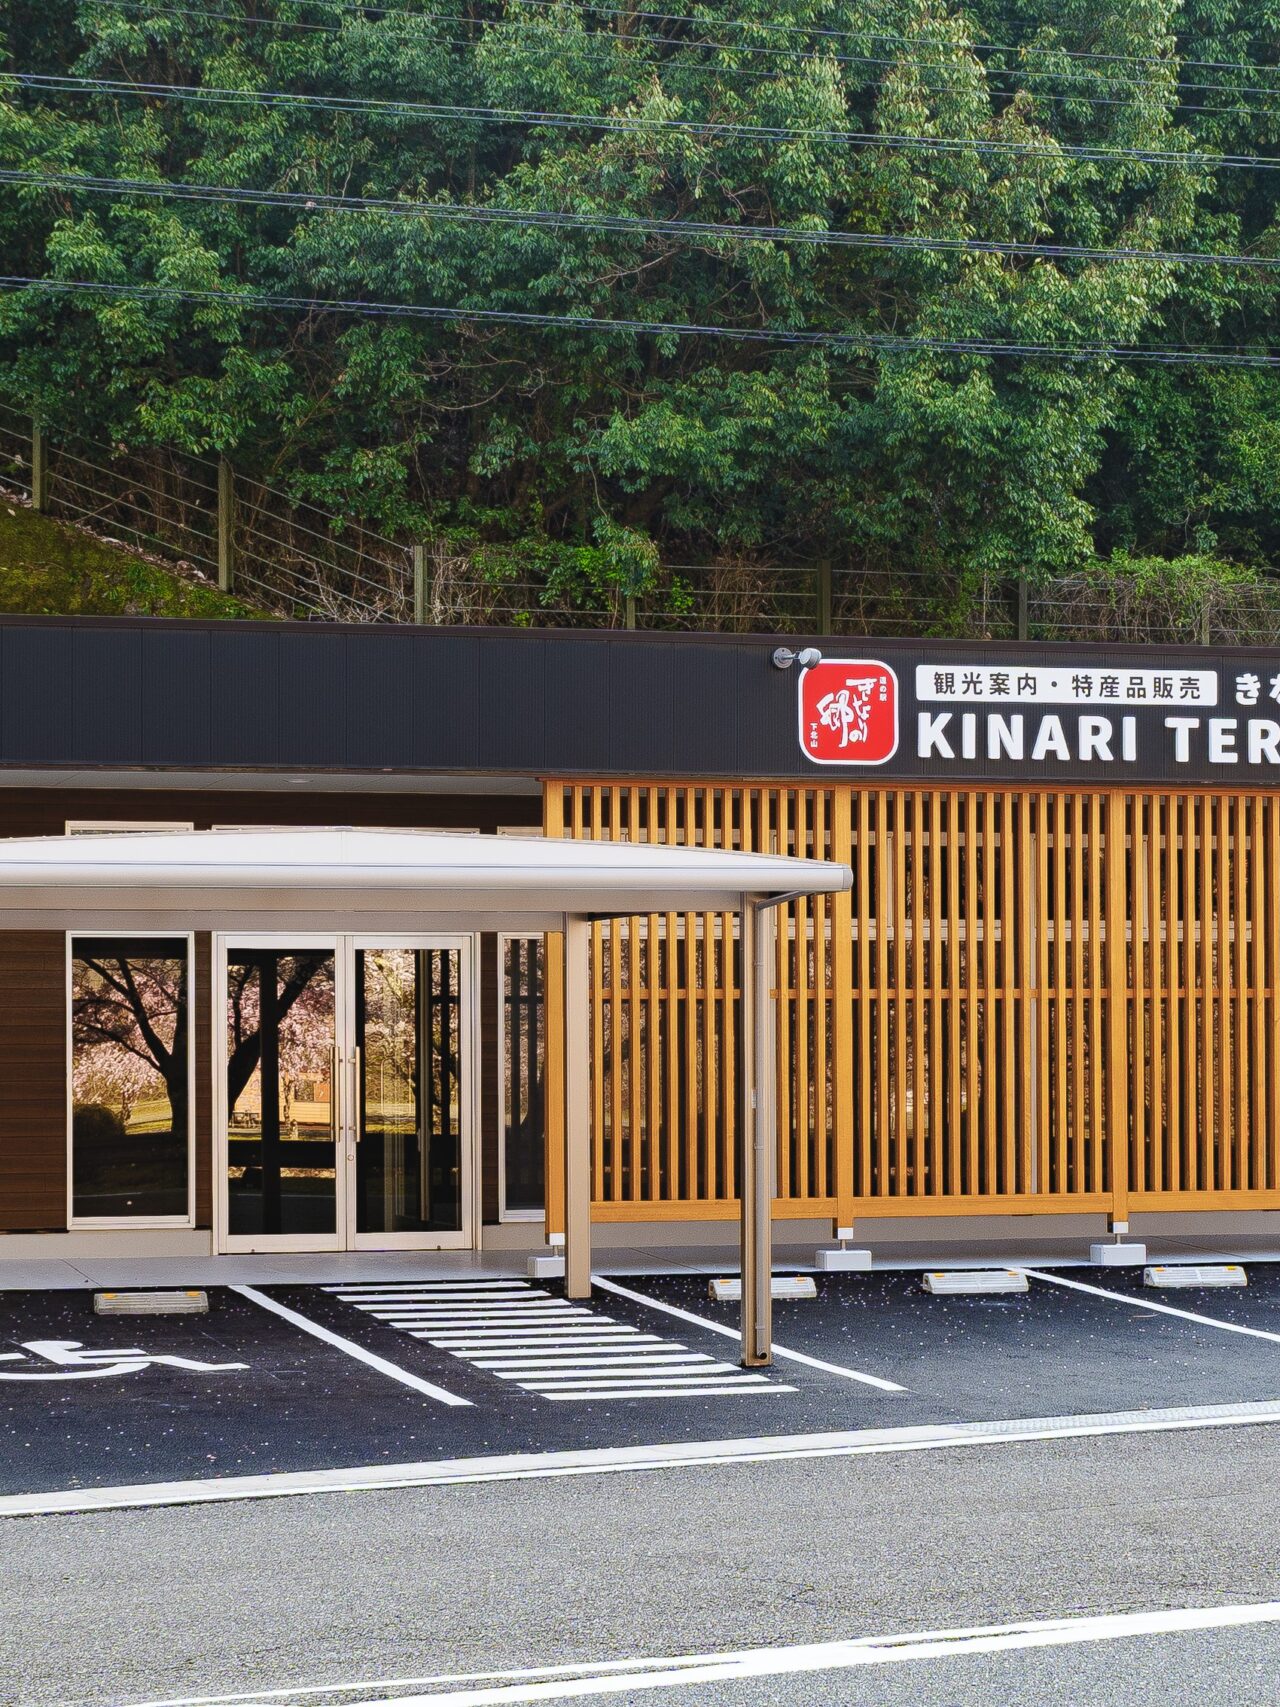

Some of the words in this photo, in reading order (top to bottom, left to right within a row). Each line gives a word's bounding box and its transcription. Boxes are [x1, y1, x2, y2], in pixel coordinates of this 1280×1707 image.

[933, 671, 1201, 699] 観光案内・特産品販売
[917, 712, 1136, 761] KINARI
